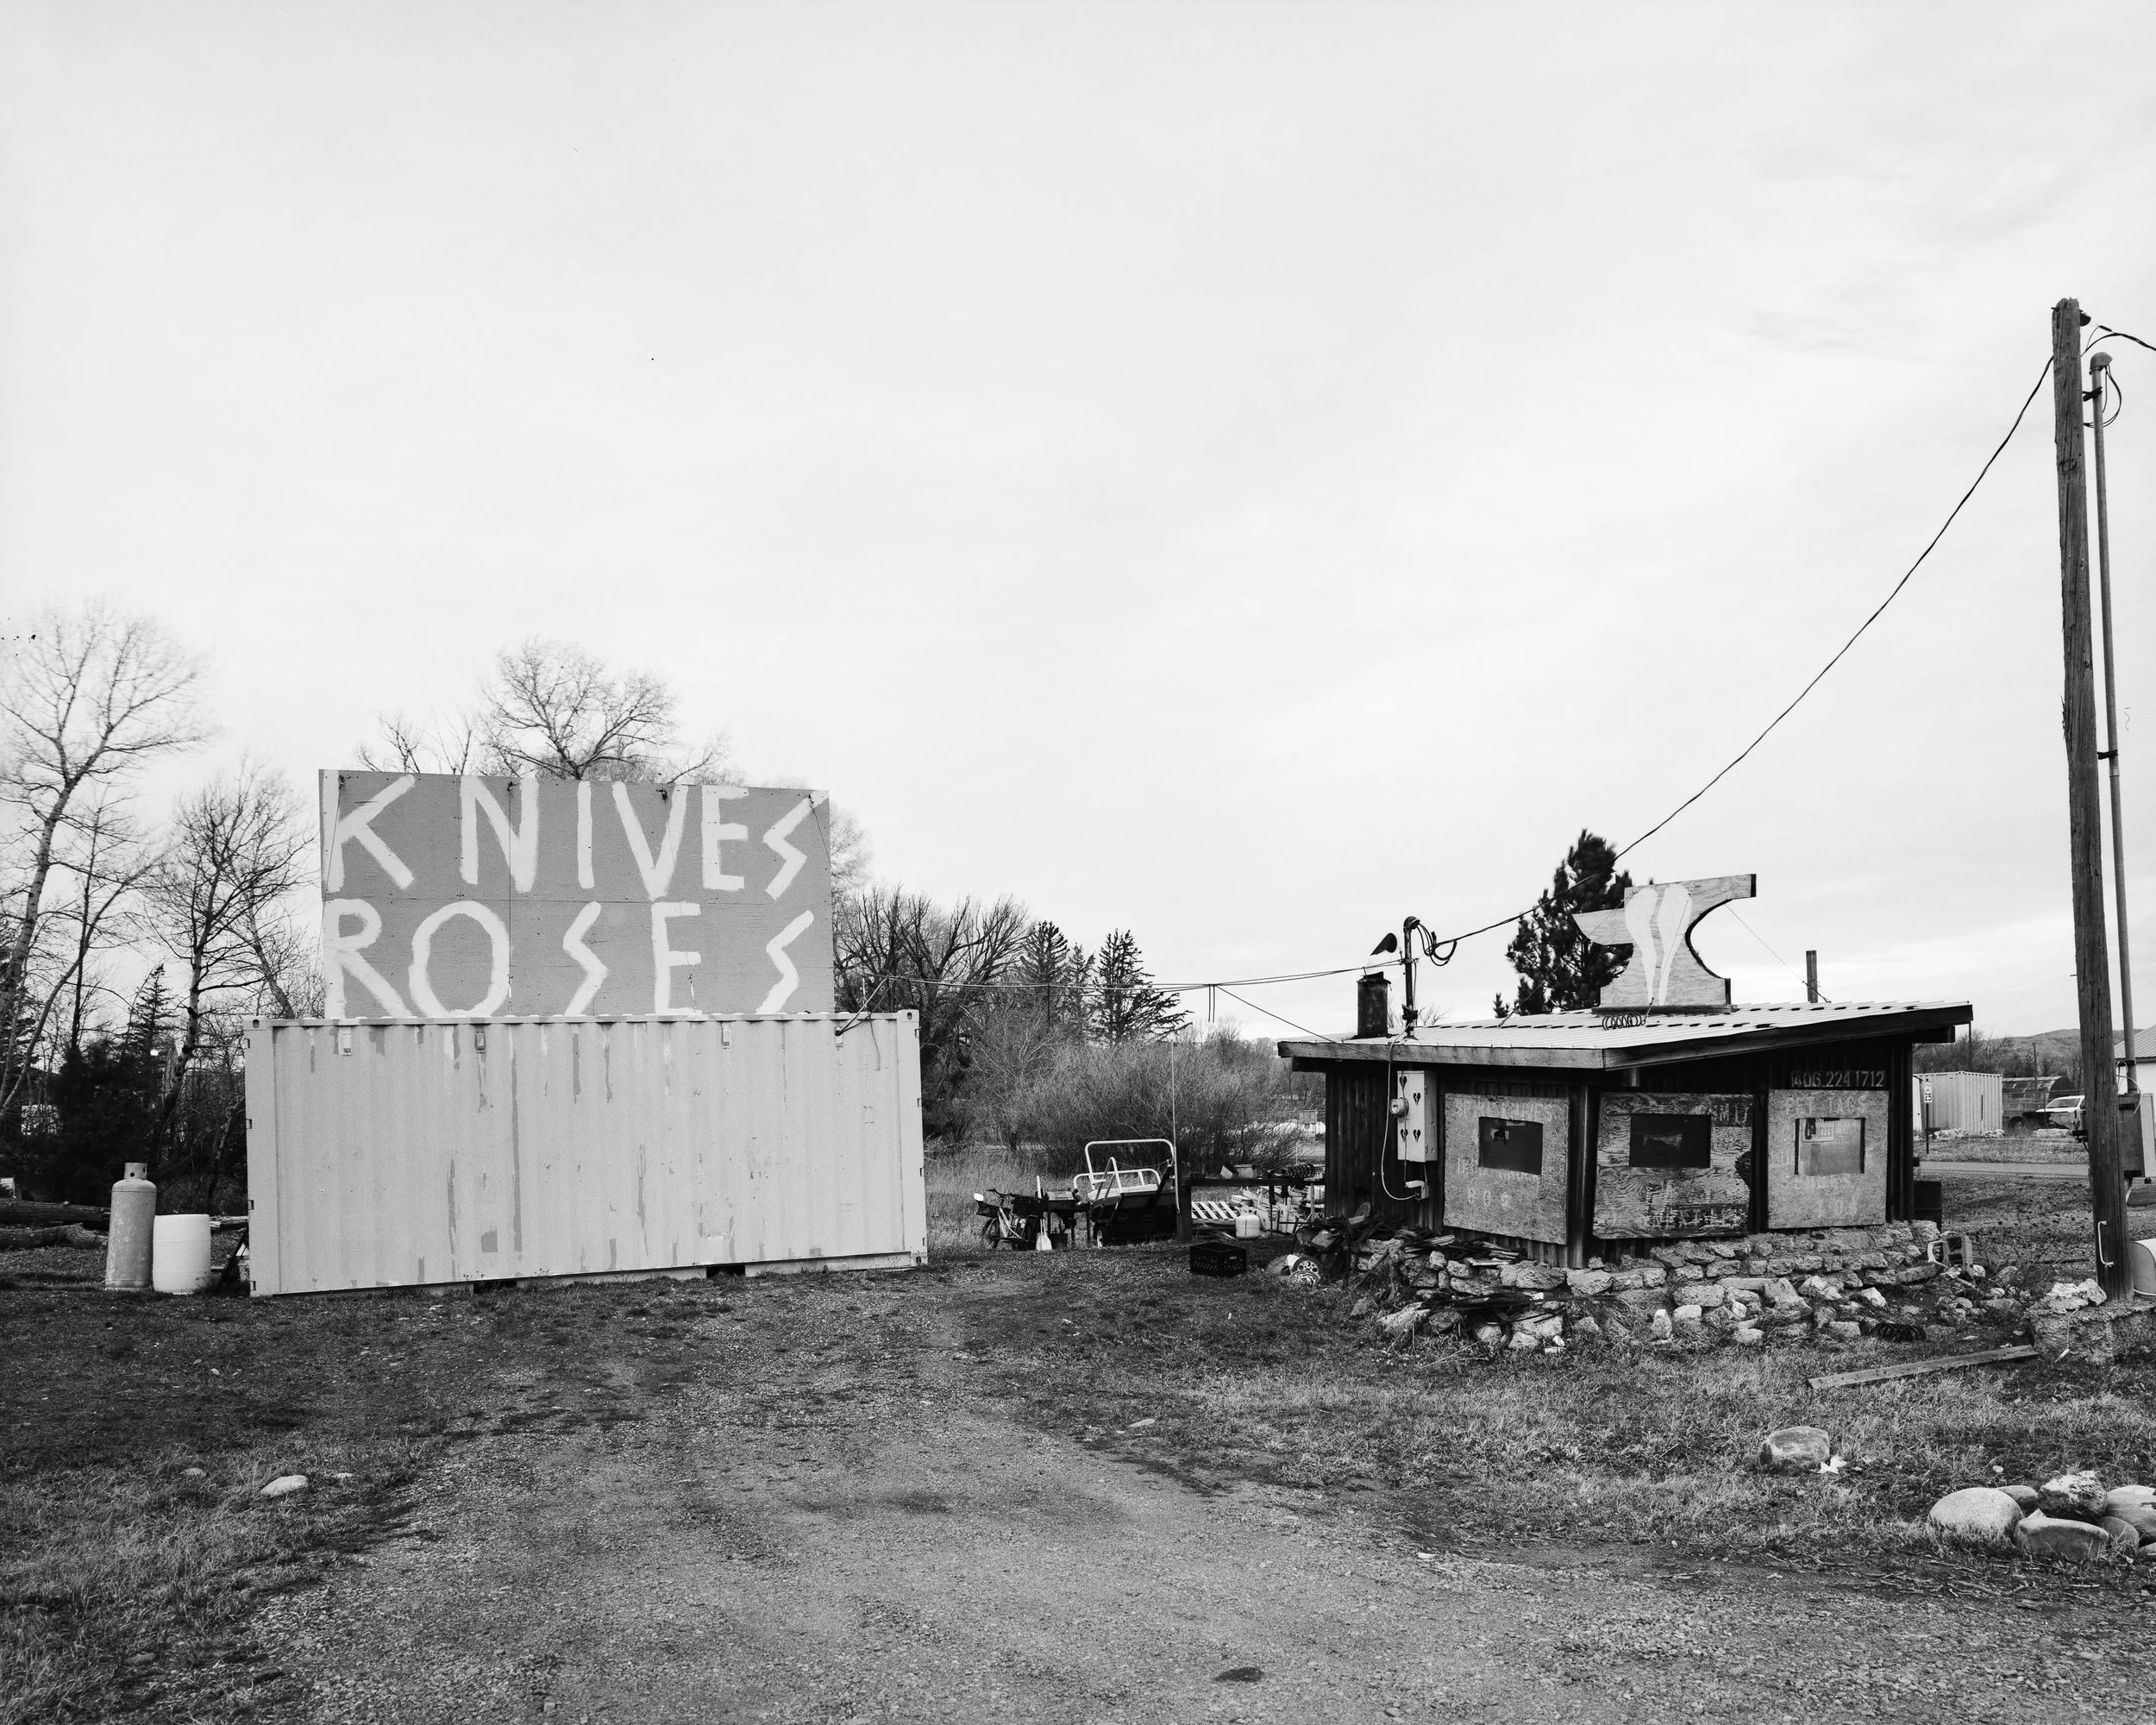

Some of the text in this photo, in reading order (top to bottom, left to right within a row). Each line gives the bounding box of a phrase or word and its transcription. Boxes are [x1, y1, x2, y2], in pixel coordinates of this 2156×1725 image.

[322, 769, 830, 900] KNIVES
[323, 898, 814, 1018] ROSES
[1924, 1092, 1932, 1101] 25
